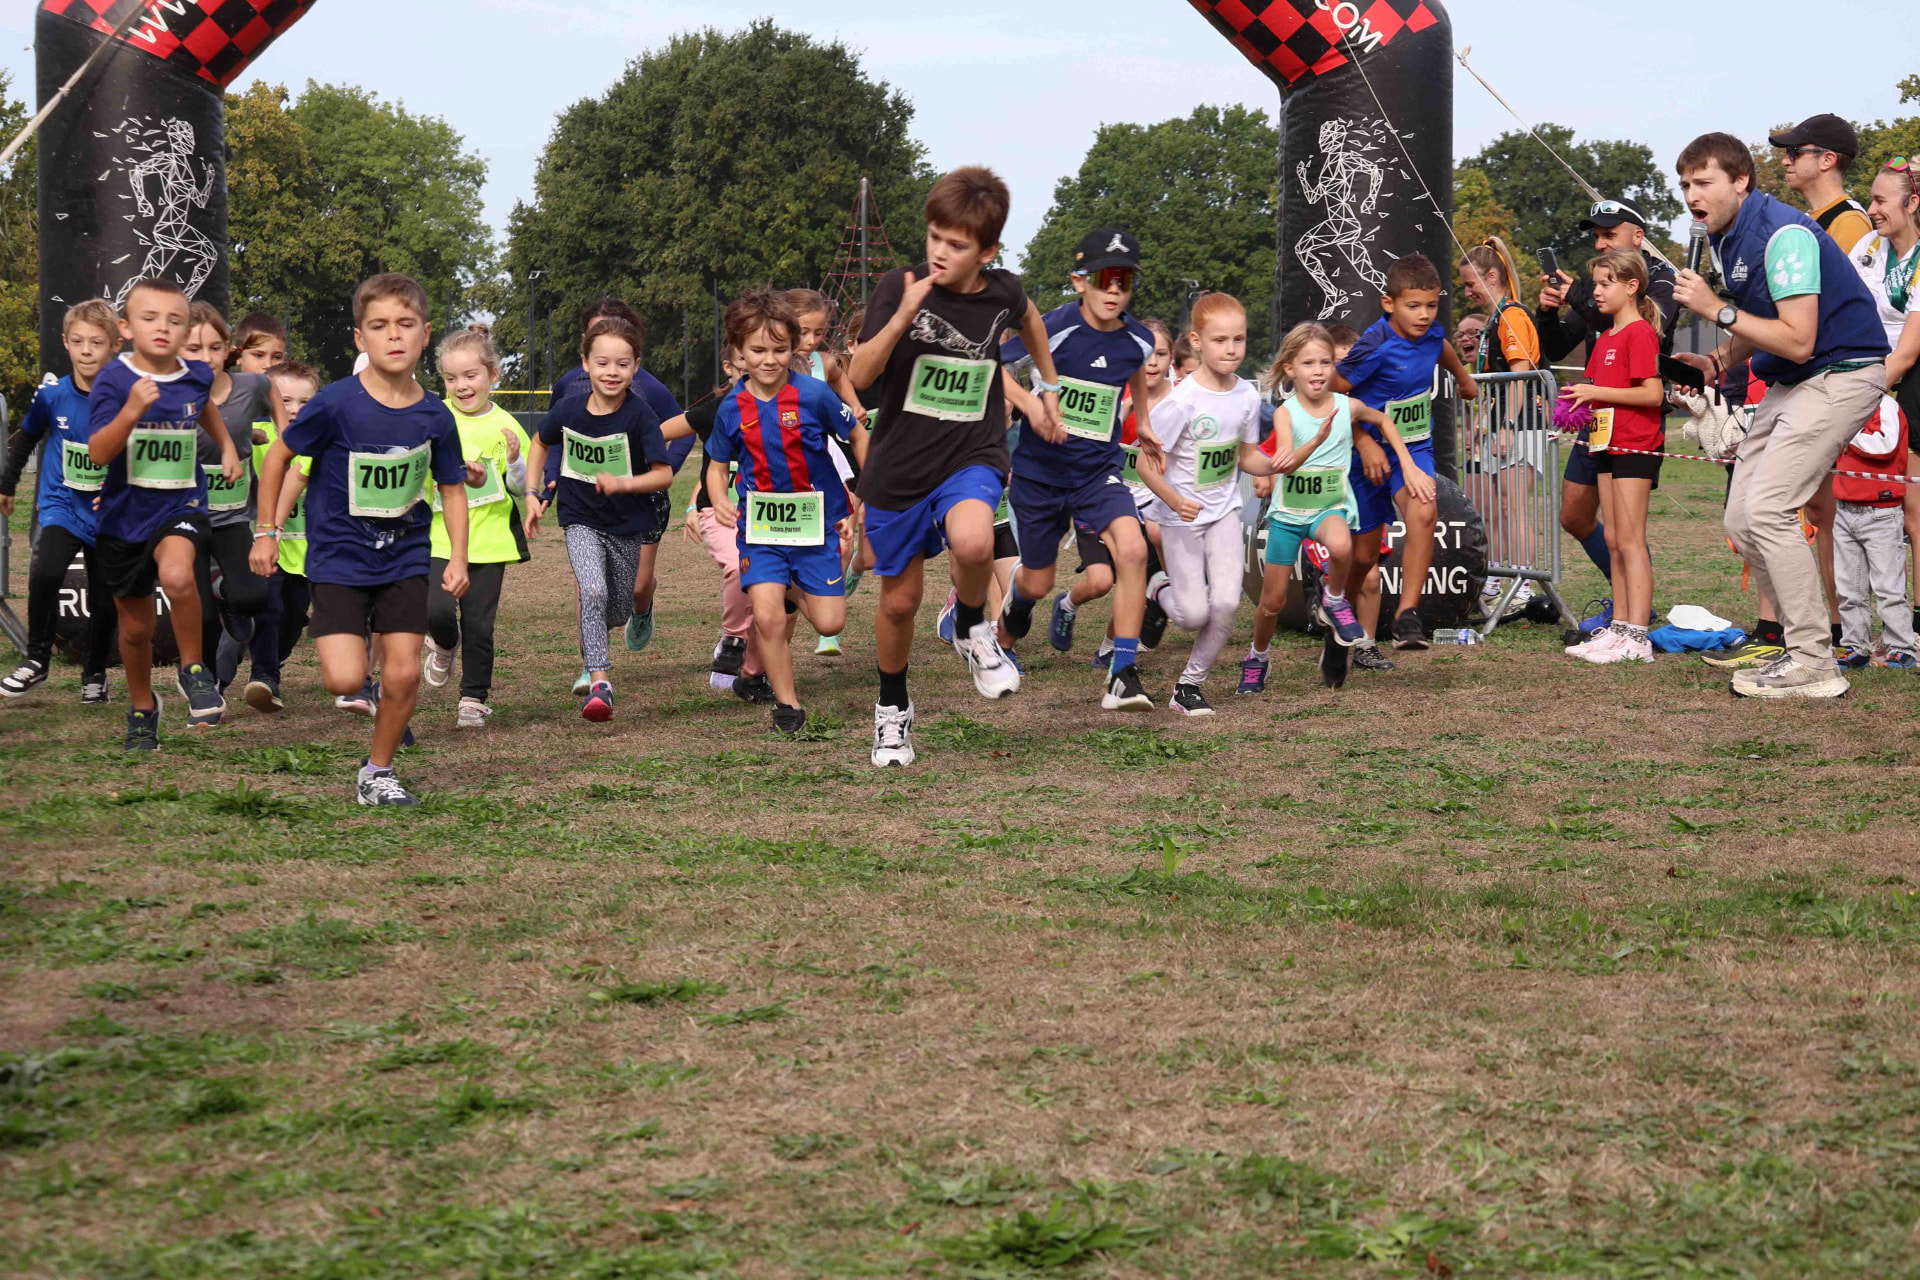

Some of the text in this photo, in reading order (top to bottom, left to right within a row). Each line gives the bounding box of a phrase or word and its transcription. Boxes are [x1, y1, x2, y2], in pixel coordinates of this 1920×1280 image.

[920, 365, 970, 394] 7014
[1059, 385, 1097, 414] 7015
[1392, 402, 1425, 425] 7001
[135, 439, 183, 462] 7040
[567, 437, 606, 465] 7020
[359, 462, 411, 490] 7017
[1286, 474, 1323, 495] 7018
[755, 501, 797, 523] 7012
